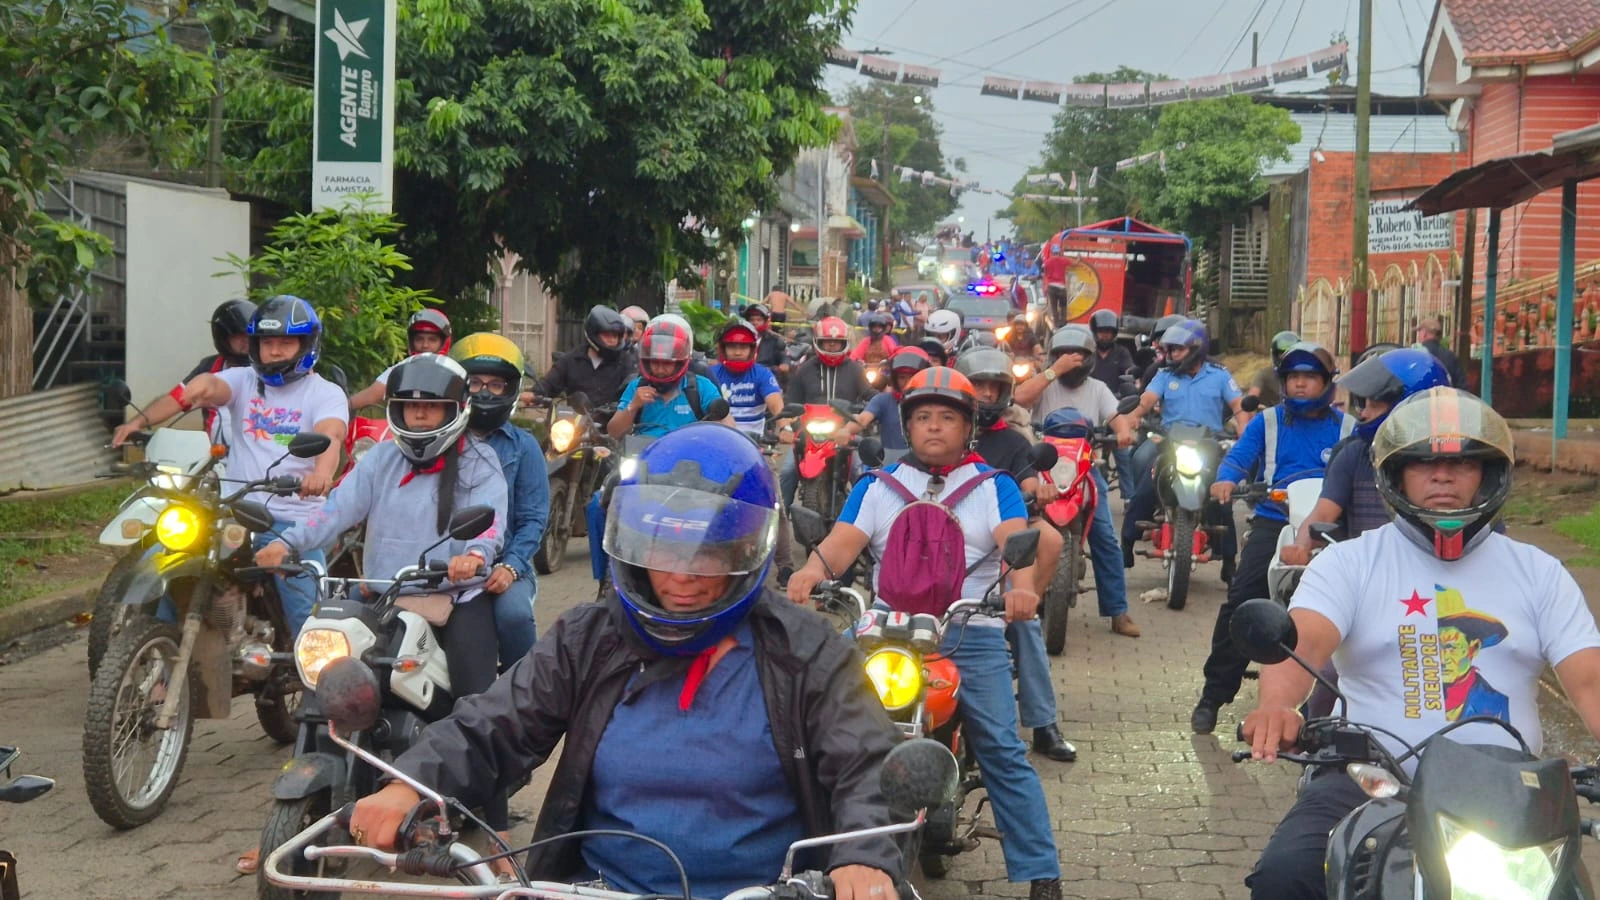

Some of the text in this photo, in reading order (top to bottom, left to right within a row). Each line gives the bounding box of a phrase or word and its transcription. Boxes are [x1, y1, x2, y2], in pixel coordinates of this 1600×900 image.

[358, 69, 374, 119] Banpro
[340, 65, 358, 148] AGENTE
[320, 184, 332, 193] LA
[325, 175, 371, 183] FARMACIA
[1376, 216, 1412, 234] Roberto
[1414, 213, 1450, 232] Martine
[1369, 234, 1403, 243] ogado
[641, 513, 709, 530] LS2
[1398, 624, 1421, 719] MILITANTE
[1420, 633, 1442, 711] SIEMPRE
